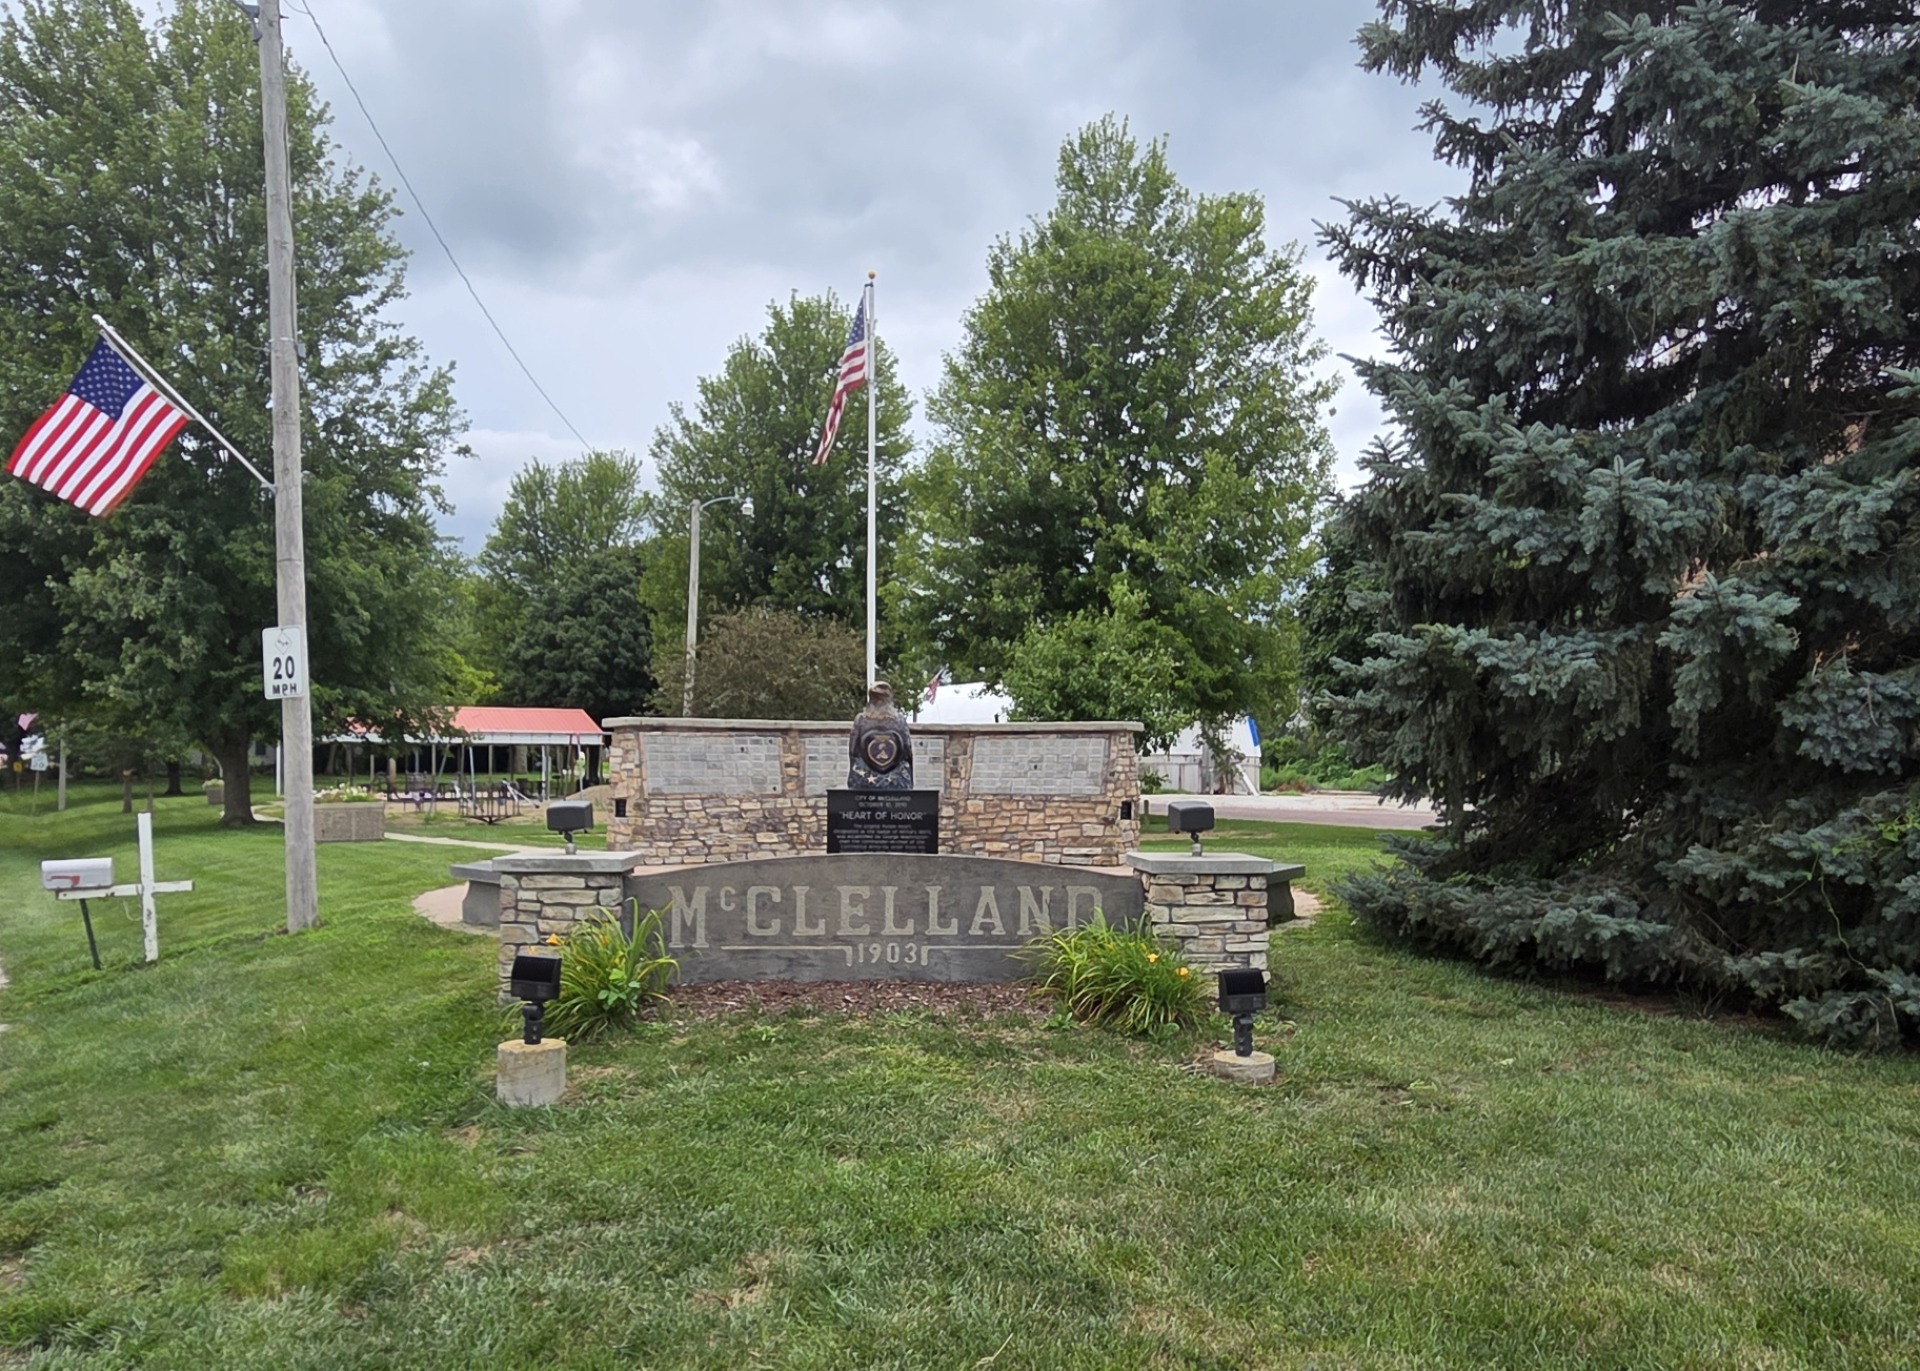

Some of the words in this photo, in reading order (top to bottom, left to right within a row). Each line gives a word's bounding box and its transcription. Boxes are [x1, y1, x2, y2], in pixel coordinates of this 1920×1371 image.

[273, 655, 295, 680] 20
[272, 683, 297, 695] MPH
[874, 811, 888, 820] OF
[858, 942, 917, 965] 1903
